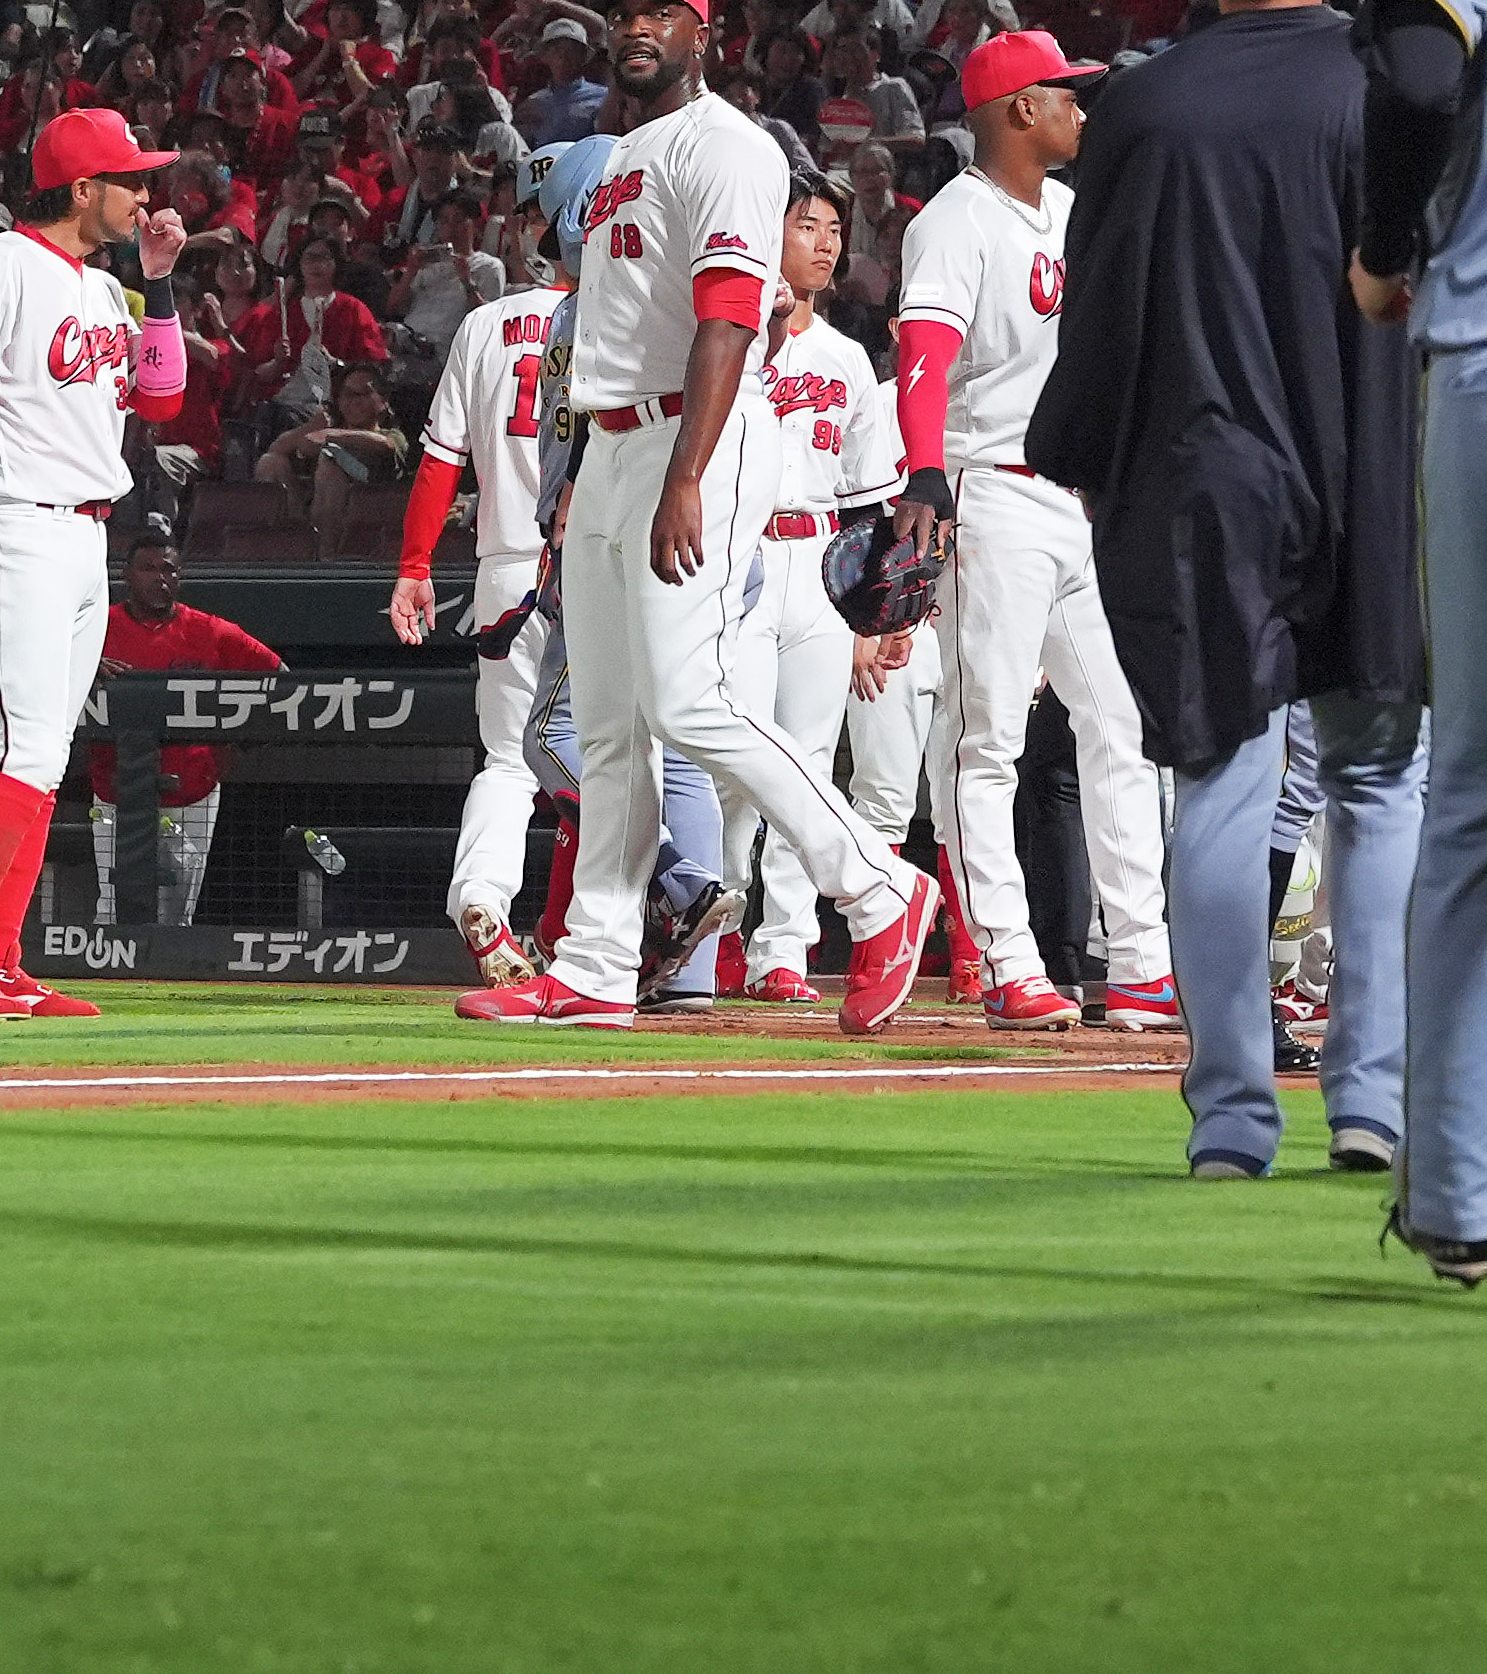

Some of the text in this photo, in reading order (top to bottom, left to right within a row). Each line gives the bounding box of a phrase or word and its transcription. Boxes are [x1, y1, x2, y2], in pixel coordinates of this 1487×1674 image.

[165, 675, 415, 730] エディオン
[228, 930, 409, 975] エディオン
